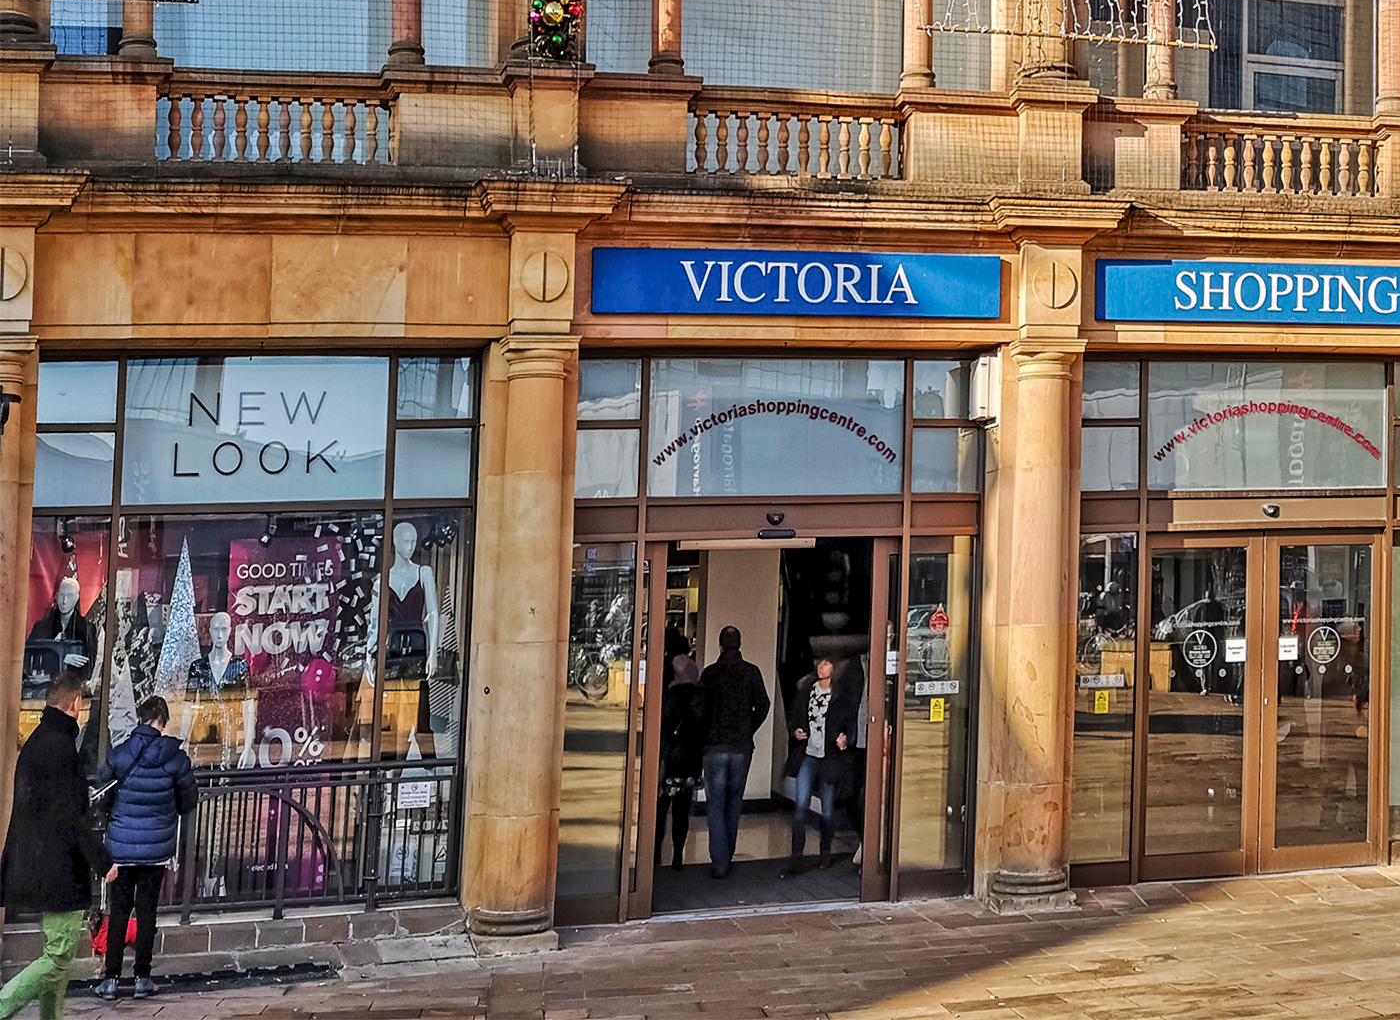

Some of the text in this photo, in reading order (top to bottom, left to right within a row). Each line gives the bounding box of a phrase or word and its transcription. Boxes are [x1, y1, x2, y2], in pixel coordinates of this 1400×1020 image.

[679, 261, 918, 304] VICTORIA
[1174, 271, 1400, 314] SHOPPING
[189, 391, 327, 426] NEW
[652, 399, 897, 467] www.victoriashoppingcentre.com
[1153, 400, 1382, 462] www.victoriashoppingcentre.com
[173, 439, 338, 476] LOOK
[236, 563, 286, 579] GOOD
[234, 583, 330, 616] START
[234, 619, 330, 656] NOW
